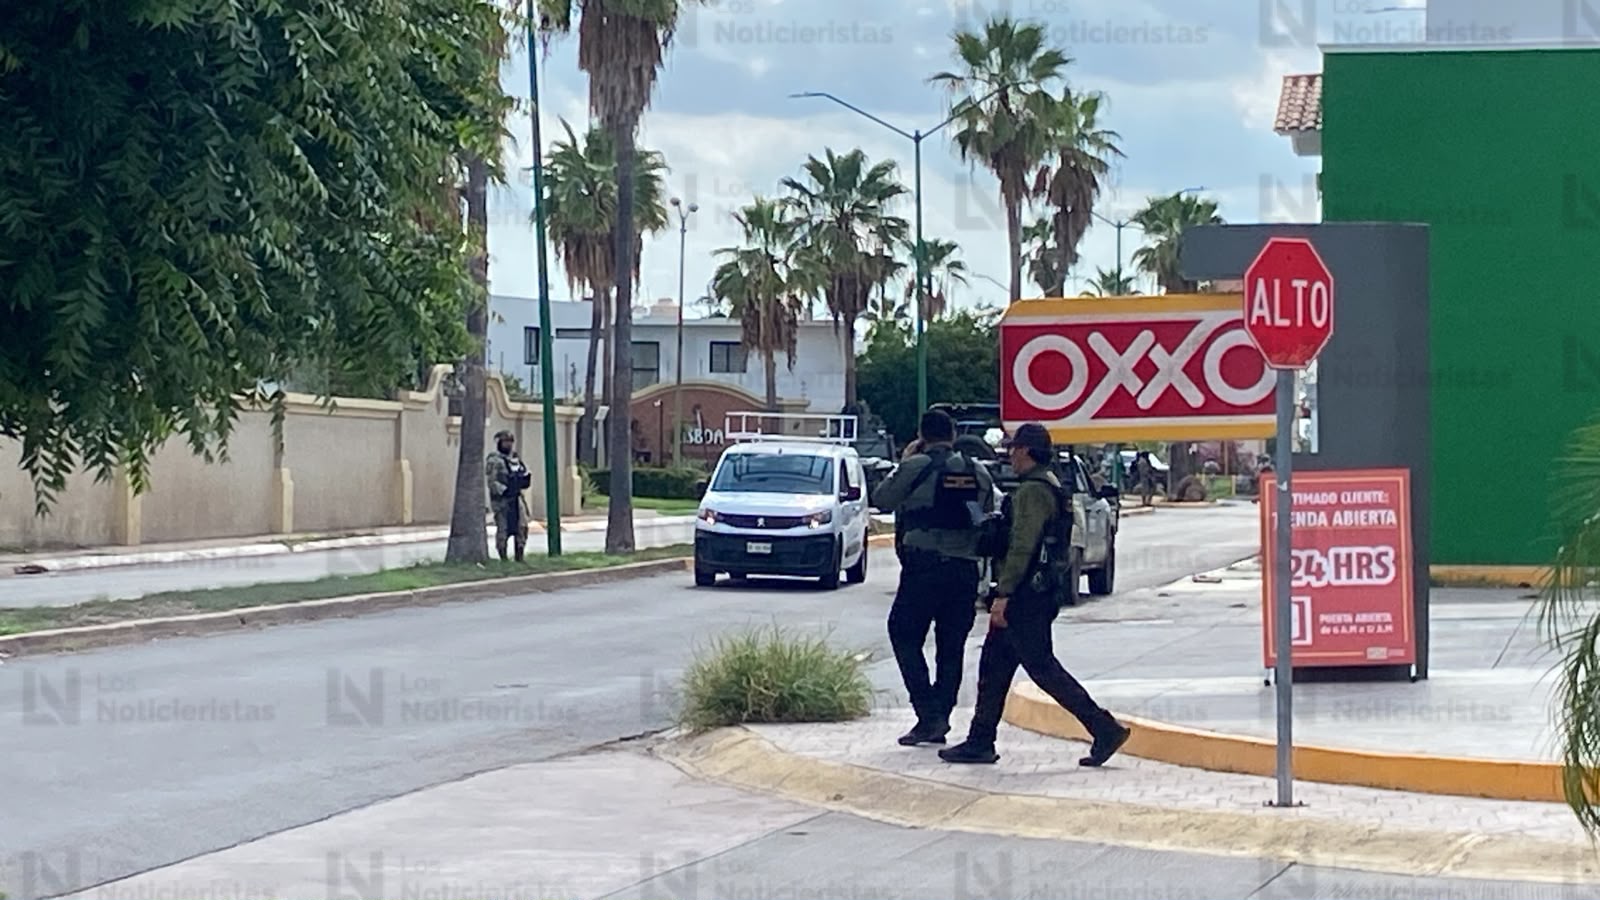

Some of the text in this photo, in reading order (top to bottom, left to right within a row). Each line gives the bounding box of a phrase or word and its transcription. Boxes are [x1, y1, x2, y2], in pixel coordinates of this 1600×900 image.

[1250, 278, 1329, 328] ALTO
[1012, 314, 1278, 422] OXXO
[1291, 492, 1339, 505] TIMADO
[1332, 509, 1397, 526] ABIERTA
[1290, 550, 1393, 583] 24 HRS
